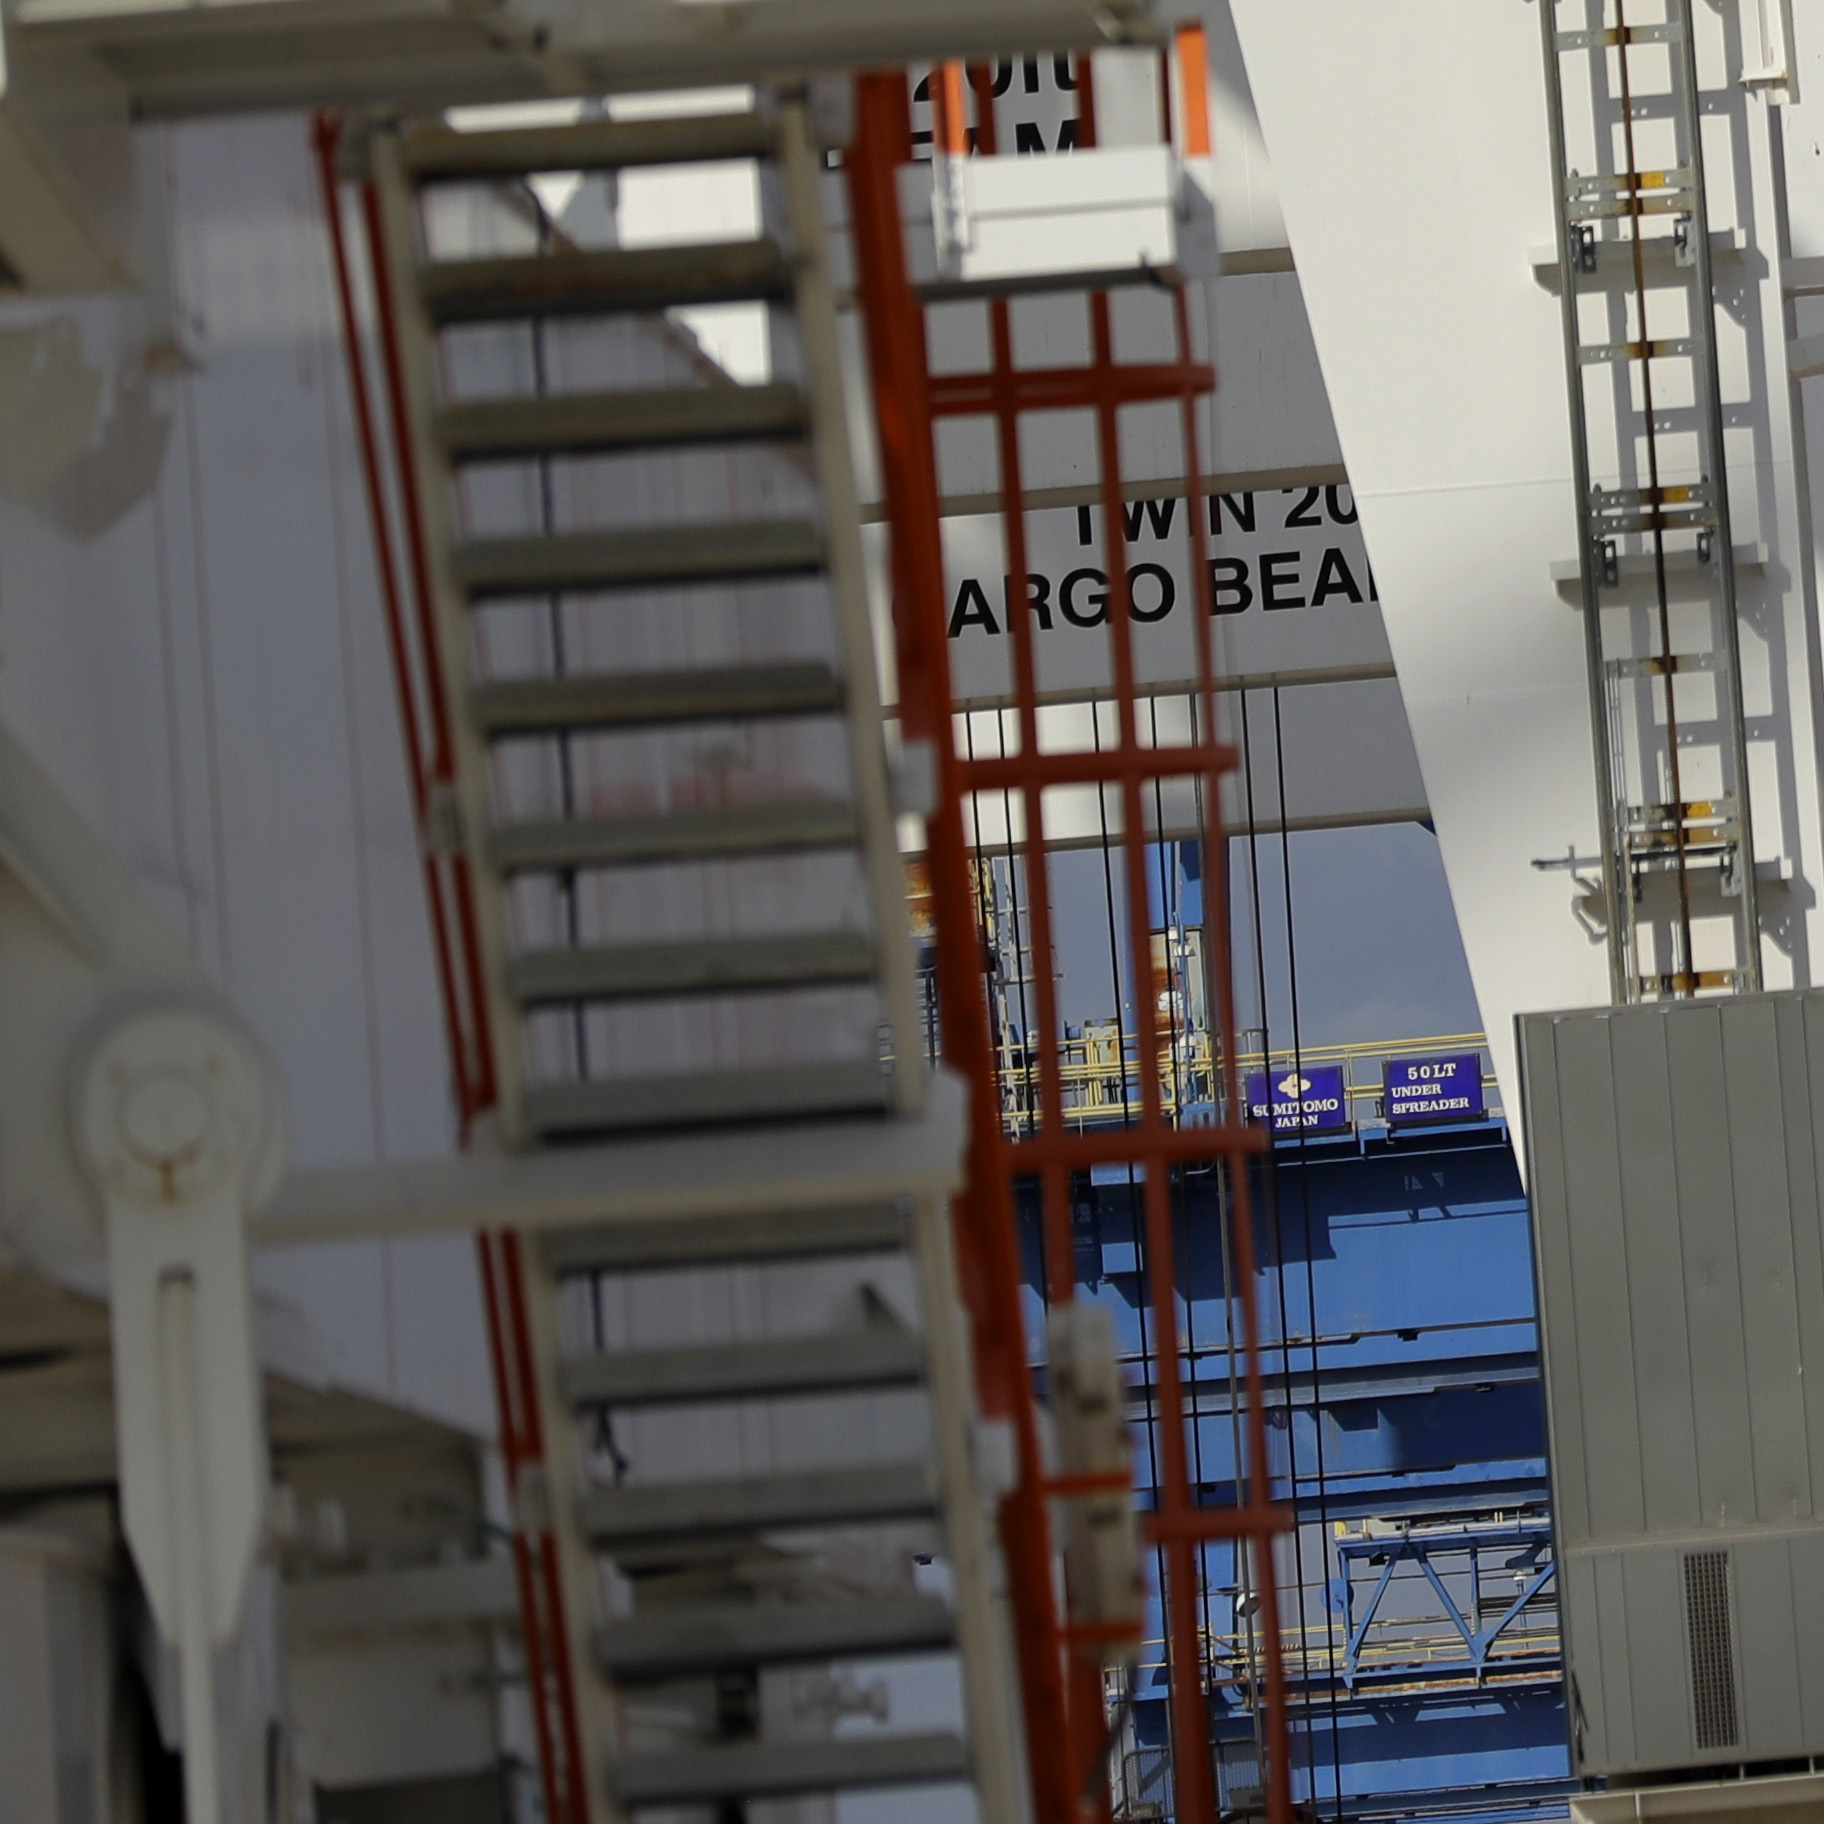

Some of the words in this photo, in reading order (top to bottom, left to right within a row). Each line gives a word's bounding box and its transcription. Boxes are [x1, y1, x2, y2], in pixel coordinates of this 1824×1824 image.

[945, 562, 1176, 639] ARGO
[1205, 547, 1379, 616] BEA
[1391, 1083, 1443, 1098] UNDER
[1252, 1098, 1339, 1118] SUMITOMO
[1391, 1096, 1470, 1115] SPREADER
[1274, 1114, 1319, 1129] JAPAN
